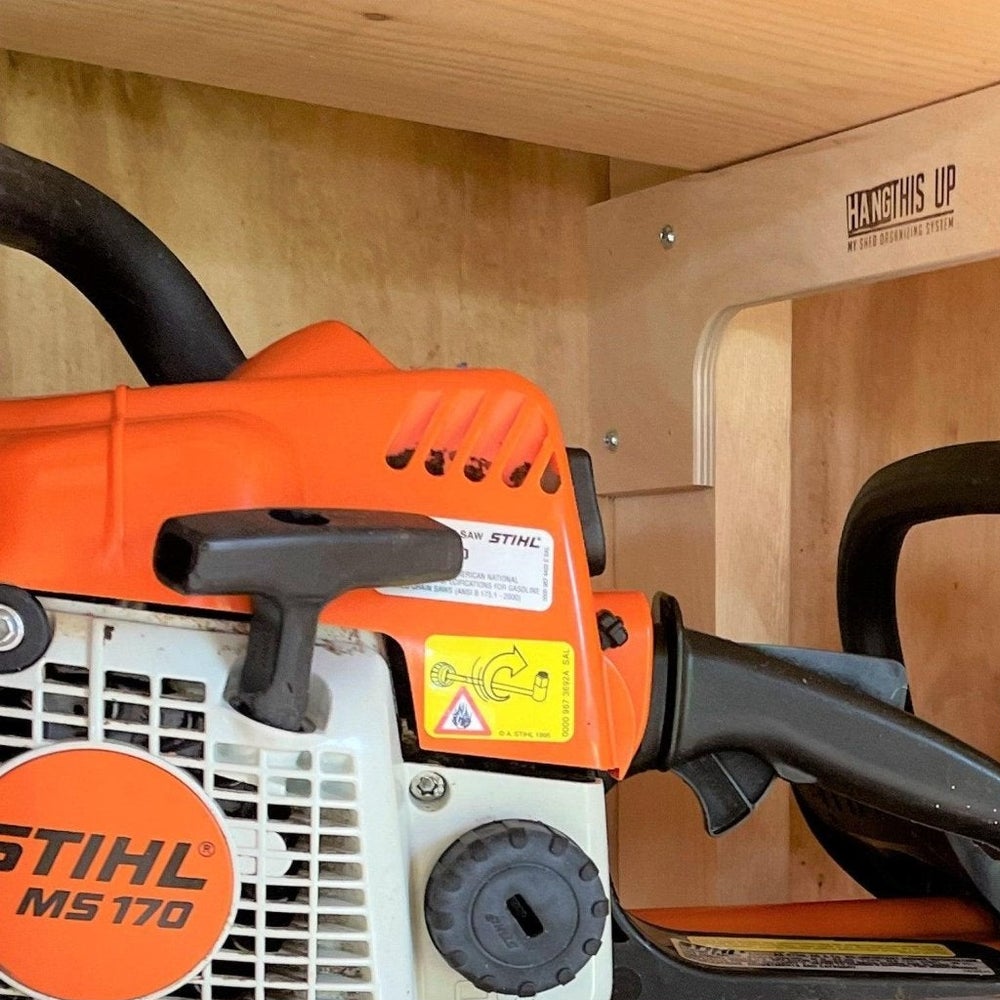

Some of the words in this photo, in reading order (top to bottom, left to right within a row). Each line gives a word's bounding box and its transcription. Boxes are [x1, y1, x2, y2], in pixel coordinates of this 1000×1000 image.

[934, 164, 956, 208] UP
[847, 239, 857, 252] MY
[860, 234, 877, 250] SHED
[879, 223, 922, 245] ORGANIZING
[926, 217, 954, 235] SYSTEM
[489, 532, 540, 548] STIHL
[487, 573, 518, 584] NATIONAL
[508, 583, 540, 595] GASOLINE
[16, 887, 104, 921] MS
[112, 896, 194, 929] 170
